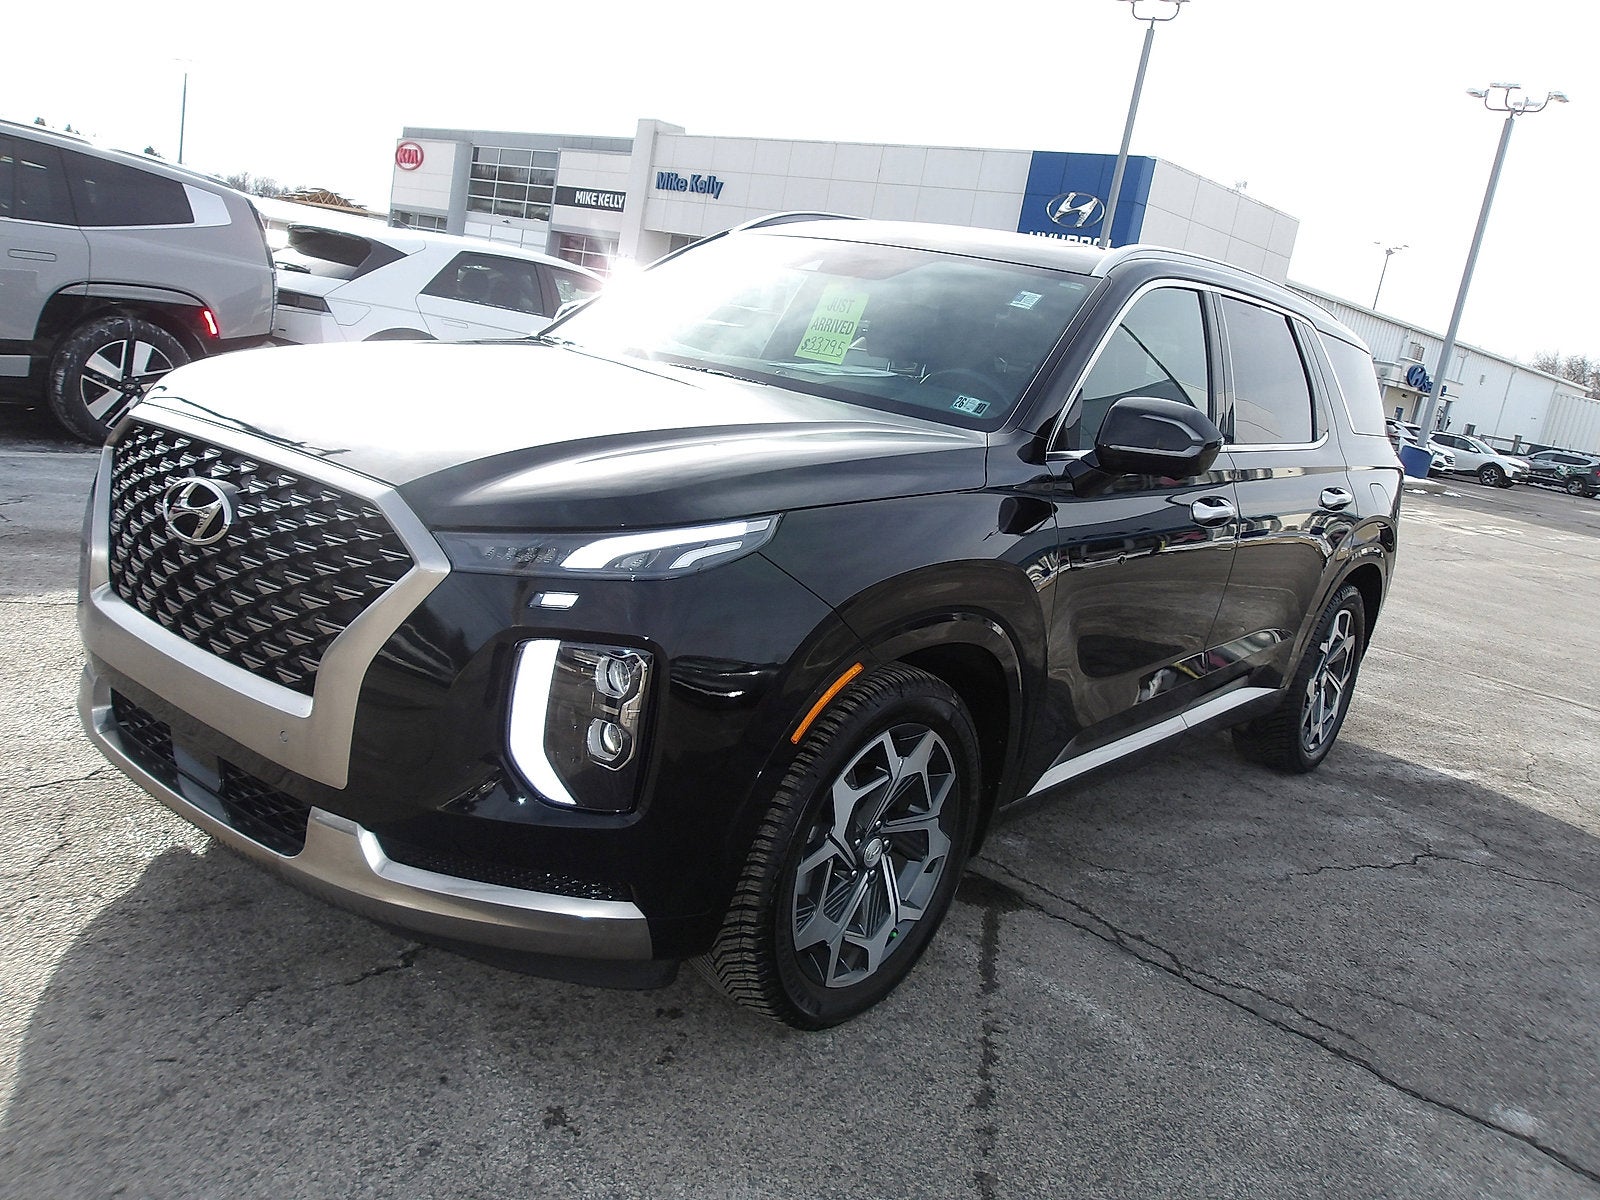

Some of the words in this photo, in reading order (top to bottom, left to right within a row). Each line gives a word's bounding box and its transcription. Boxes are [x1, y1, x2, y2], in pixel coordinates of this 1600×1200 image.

[399, 147, 419, 164] KIA
[655, 171, 688, 193] Mike
[689, 173, 724, 200] Kelly
[575, 190, 598, 206] MIKE
[598, 191, 625, 209] KELLY
[827, 296, 855, 314] JUST
[811, 317, 855, 336] ARRIVED
[954, 396, 968, 408] 26
[973, 402, 987, 414] 10
